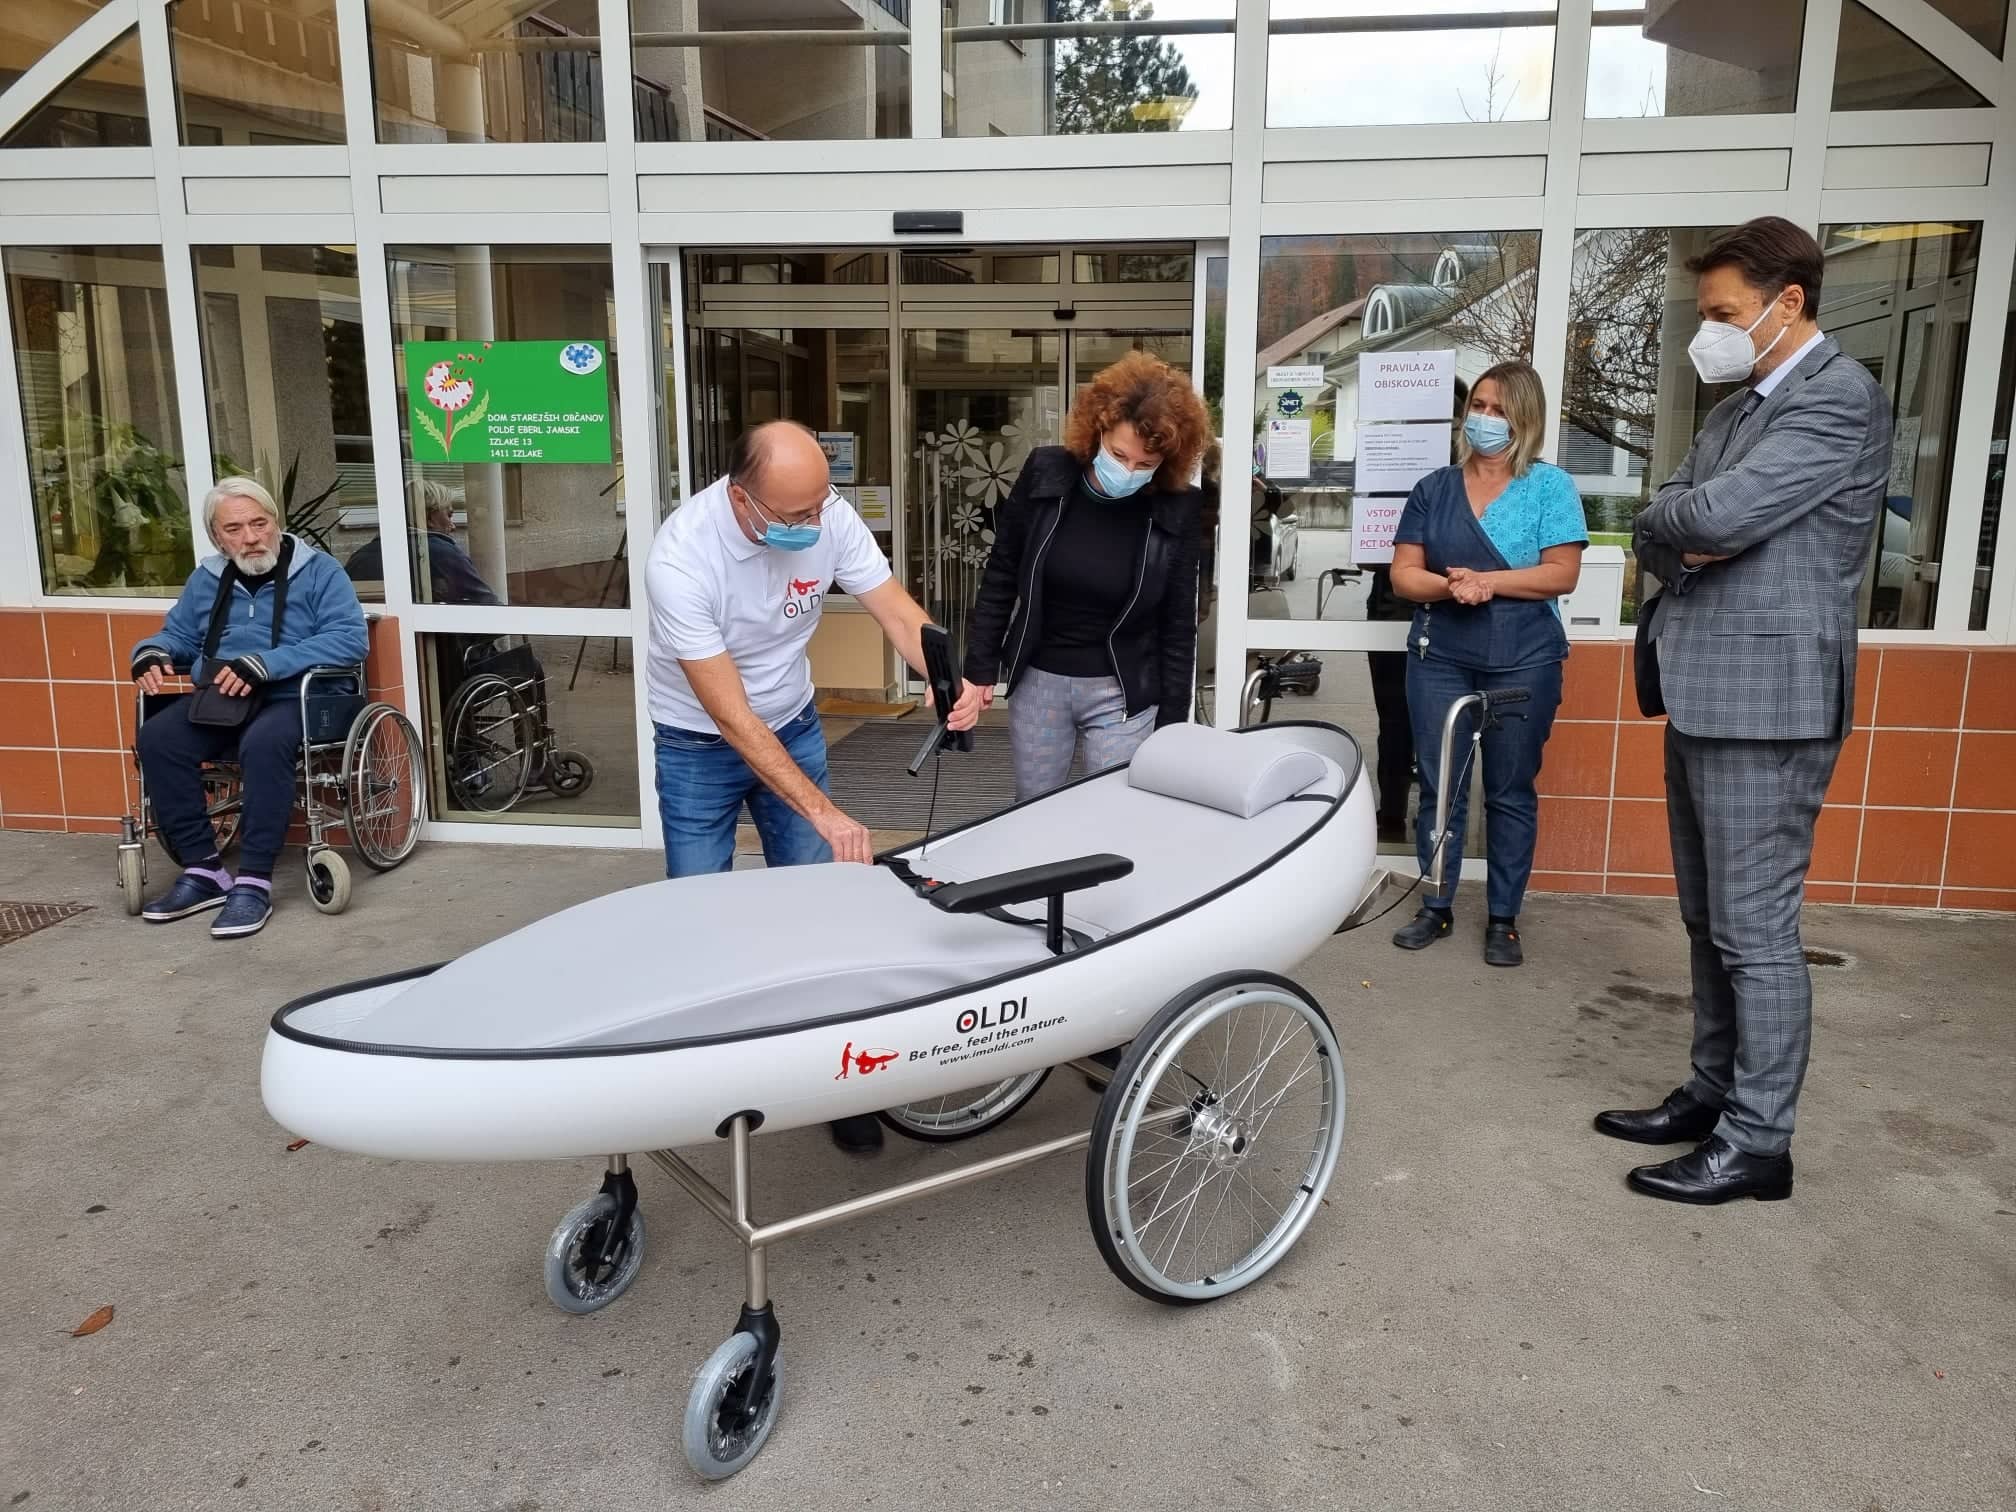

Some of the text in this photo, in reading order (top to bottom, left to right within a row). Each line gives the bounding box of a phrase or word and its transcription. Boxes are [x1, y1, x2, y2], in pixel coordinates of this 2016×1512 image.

[1380, 363, 1435, 373] PRAVILA ZA
[1374, 379, 1440, 389] OBISKOVALCE
[487, 411, 605, 422] DOM STAREJŠIH OBČANOV
[488, 425, 581, 434] POLDE EBERL JAMSKI
[489, 438, 532, 446] IZLAKE 13
[490, 449, 543, 458] 1411 IZLAKE
[1367, 509, 1398, 518] VSTOP
[1362, 524, 1373, 533] LE
[1374, 524, 1380, 533] Z
[1360, 539, 1377, 548] PCT
[956, 997, 1028, 1033] OLDI
[909, 1015, 1068, 1062] Be free, feel the nature.
[939, 1036, 1034, 1066] www.imoldi.com
